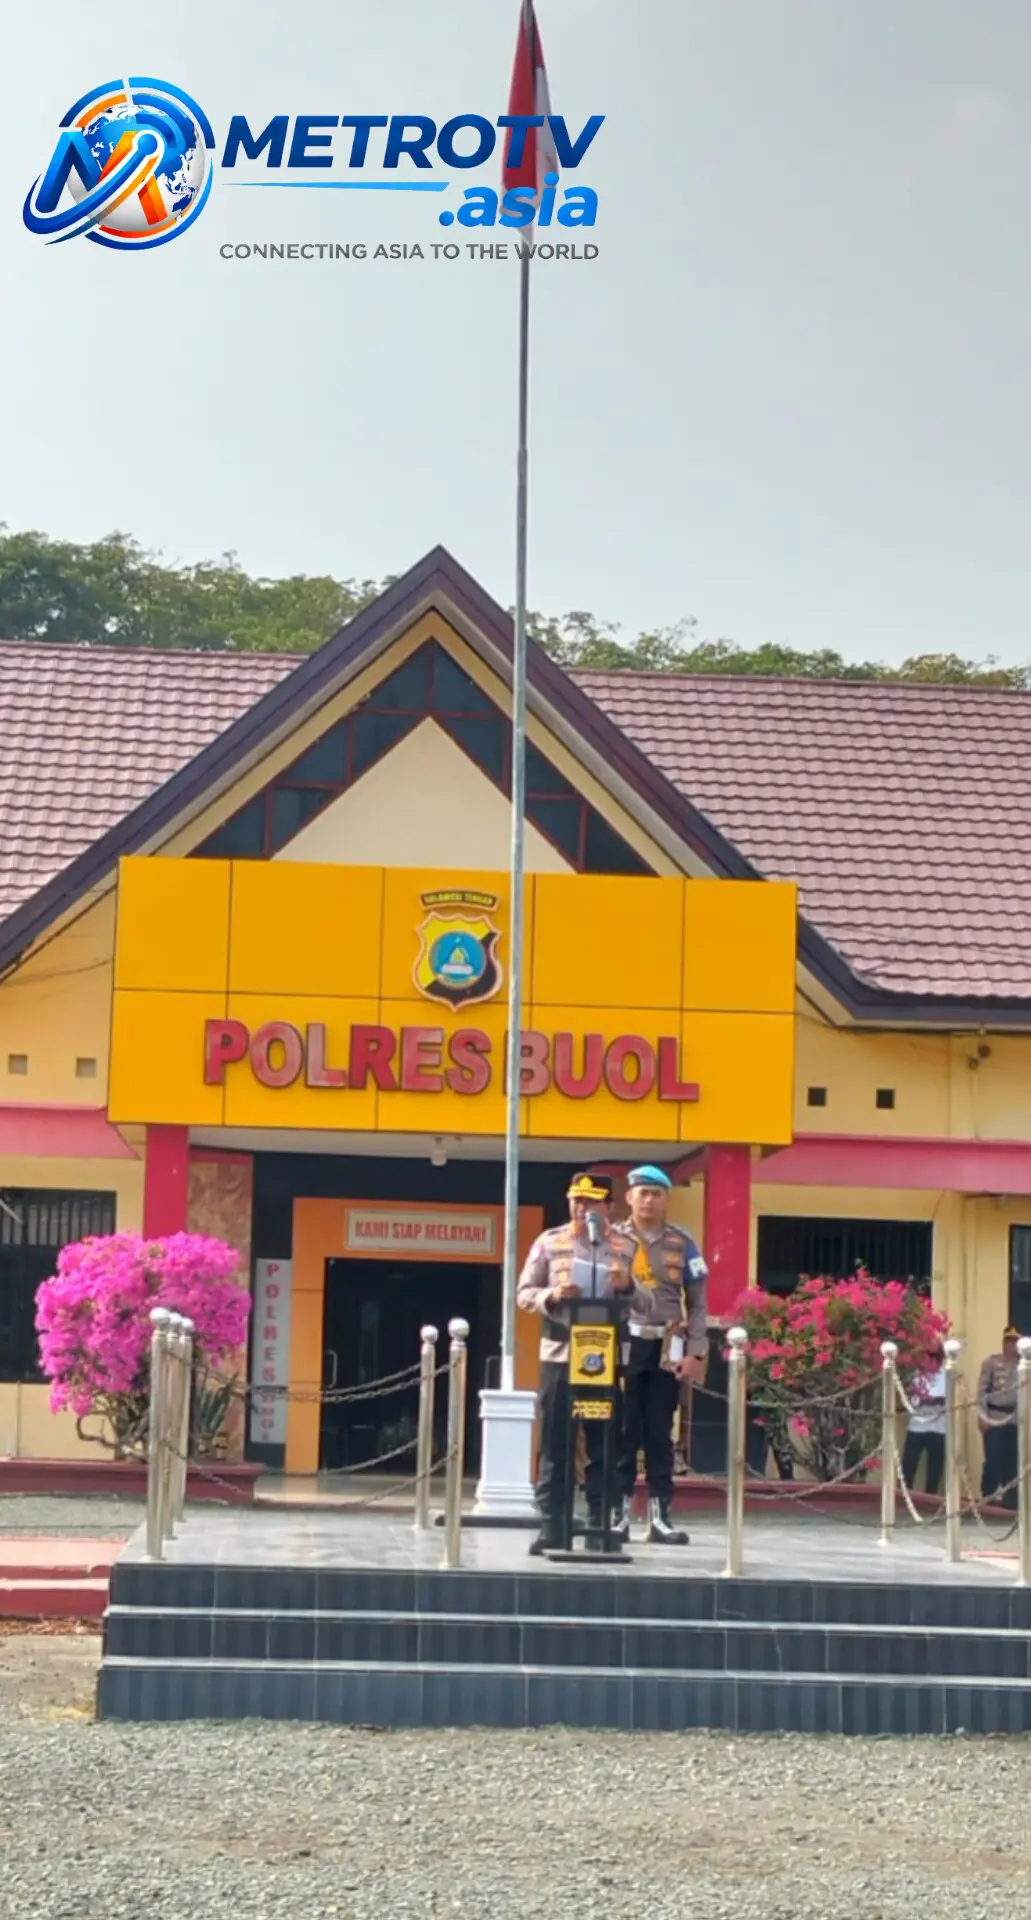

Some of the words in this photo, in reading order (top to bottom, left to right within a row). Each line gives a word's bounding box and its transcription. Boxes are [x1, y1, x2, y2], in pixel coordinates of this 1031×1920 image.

[203, 1019, 492, 1096] POLRES
[503, 1030, 700, 1103] BUOL
[355, 1222, 389, 1239] KAMI
[392, 1223, 422, 1240] SIAP
[425, 1224, 487, 1242] MELAYANI
